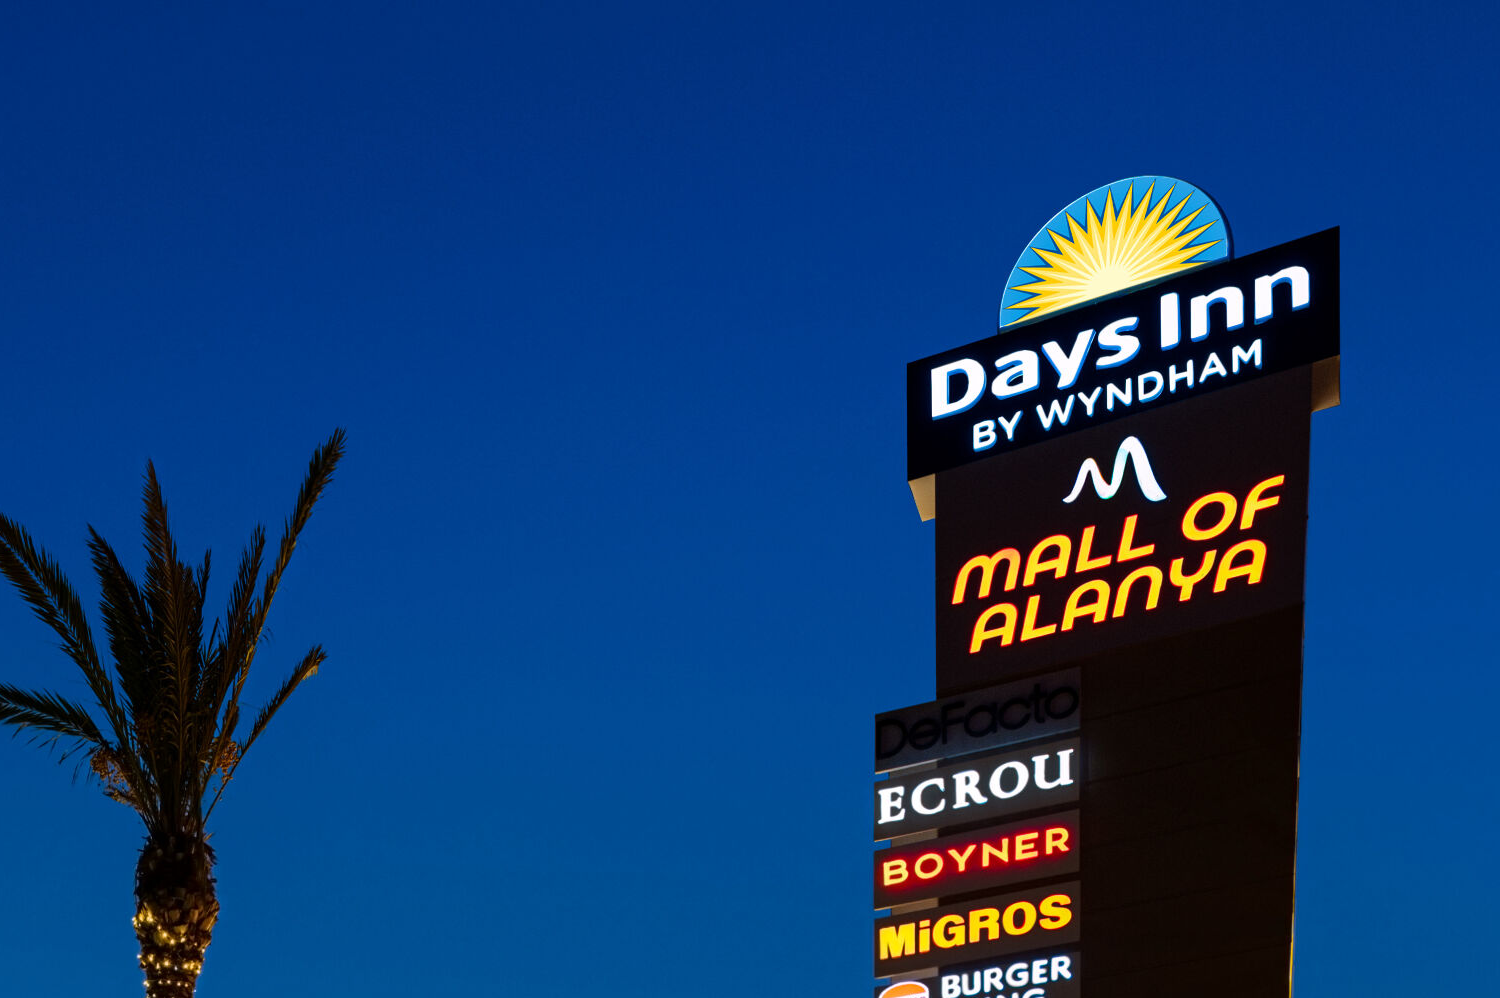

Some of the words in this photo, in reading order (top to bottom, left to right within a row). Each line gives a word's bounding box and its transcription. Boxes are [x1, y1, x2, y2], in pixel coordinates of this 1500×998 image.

[931, 316, 1140, 420] Days
[1160, 265, 1311, 351] Inn
[972, 410, 1022, 452] BY
[1036, 338, 1263, 431] WYNDHAM
[952, 514, 1155, 605] MALL
[1181, 474, 1285, 541] OF
[969, 538, 1267, 654] ALANYA
[875, 683, 1079, 760] DeFacto
[877, 748, 1075, 825] ECROU
[882, 827, 1070, 886] BOYNER
